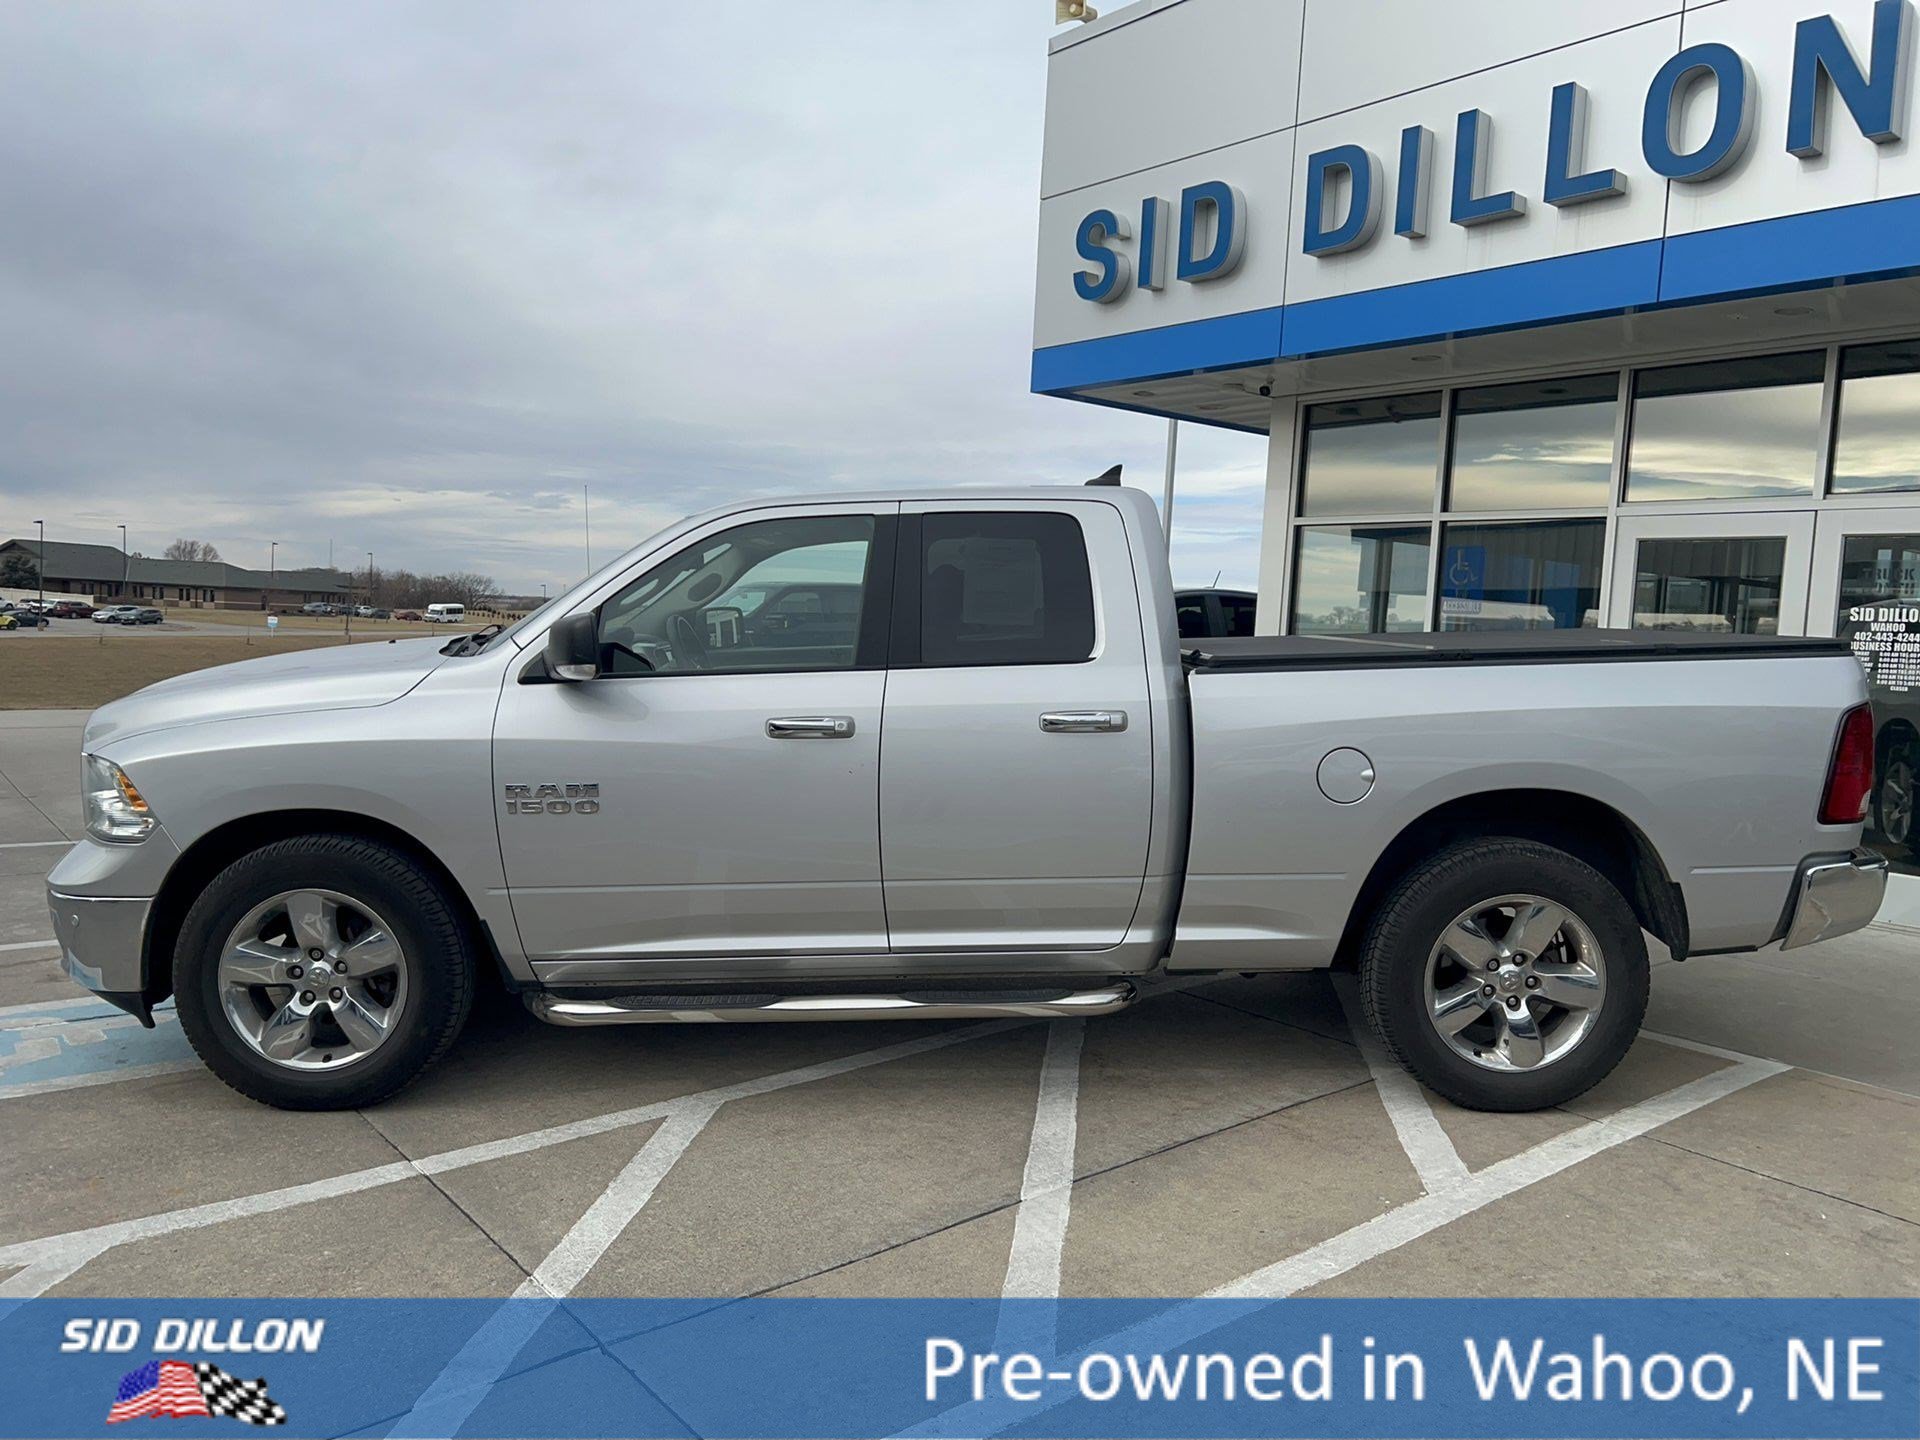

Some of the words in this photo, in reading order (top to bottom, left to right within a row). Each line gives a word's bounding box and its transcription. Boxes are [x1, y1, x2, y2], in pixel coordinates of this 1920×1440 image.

[1073, 180, 1248, 304] SID
[1302, 0, 1910, 258] DILLON
[1849, 607, 1875, 622] SID
[1878, 607, 1920, 622] DILLO
[1870, 622, 1906, 632] WAHOO
[1854, 632, 1920, 643] 402-443-4244
[505, 782, 599, 798] RAM
[506, 799, 600, 814] 1500
